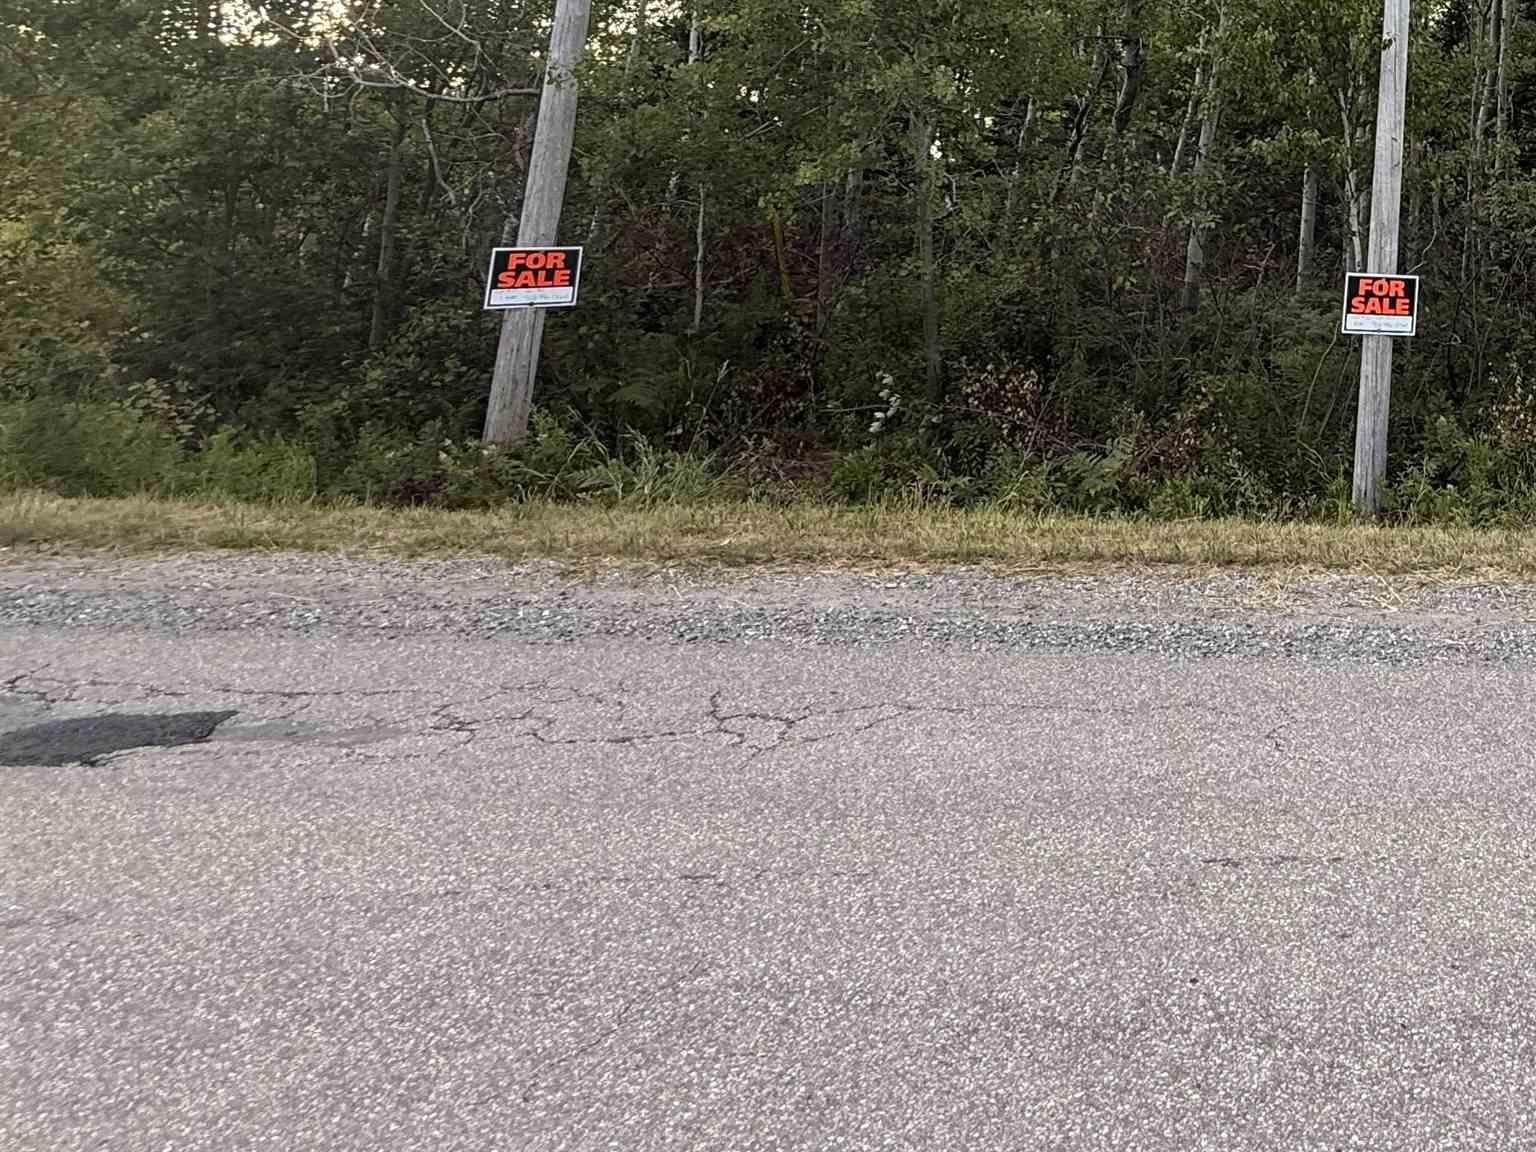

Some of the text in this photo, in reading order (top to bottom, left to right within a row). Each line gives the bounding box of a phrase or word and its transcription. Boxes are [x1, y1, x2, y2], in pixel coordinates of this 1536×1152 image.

[507, 252, 566, 269] FOR
[497, 270, 571, 288] SALE
[1358, 278, 1405, 297] FOR
[1350, 296, 1409, 315] SALE
